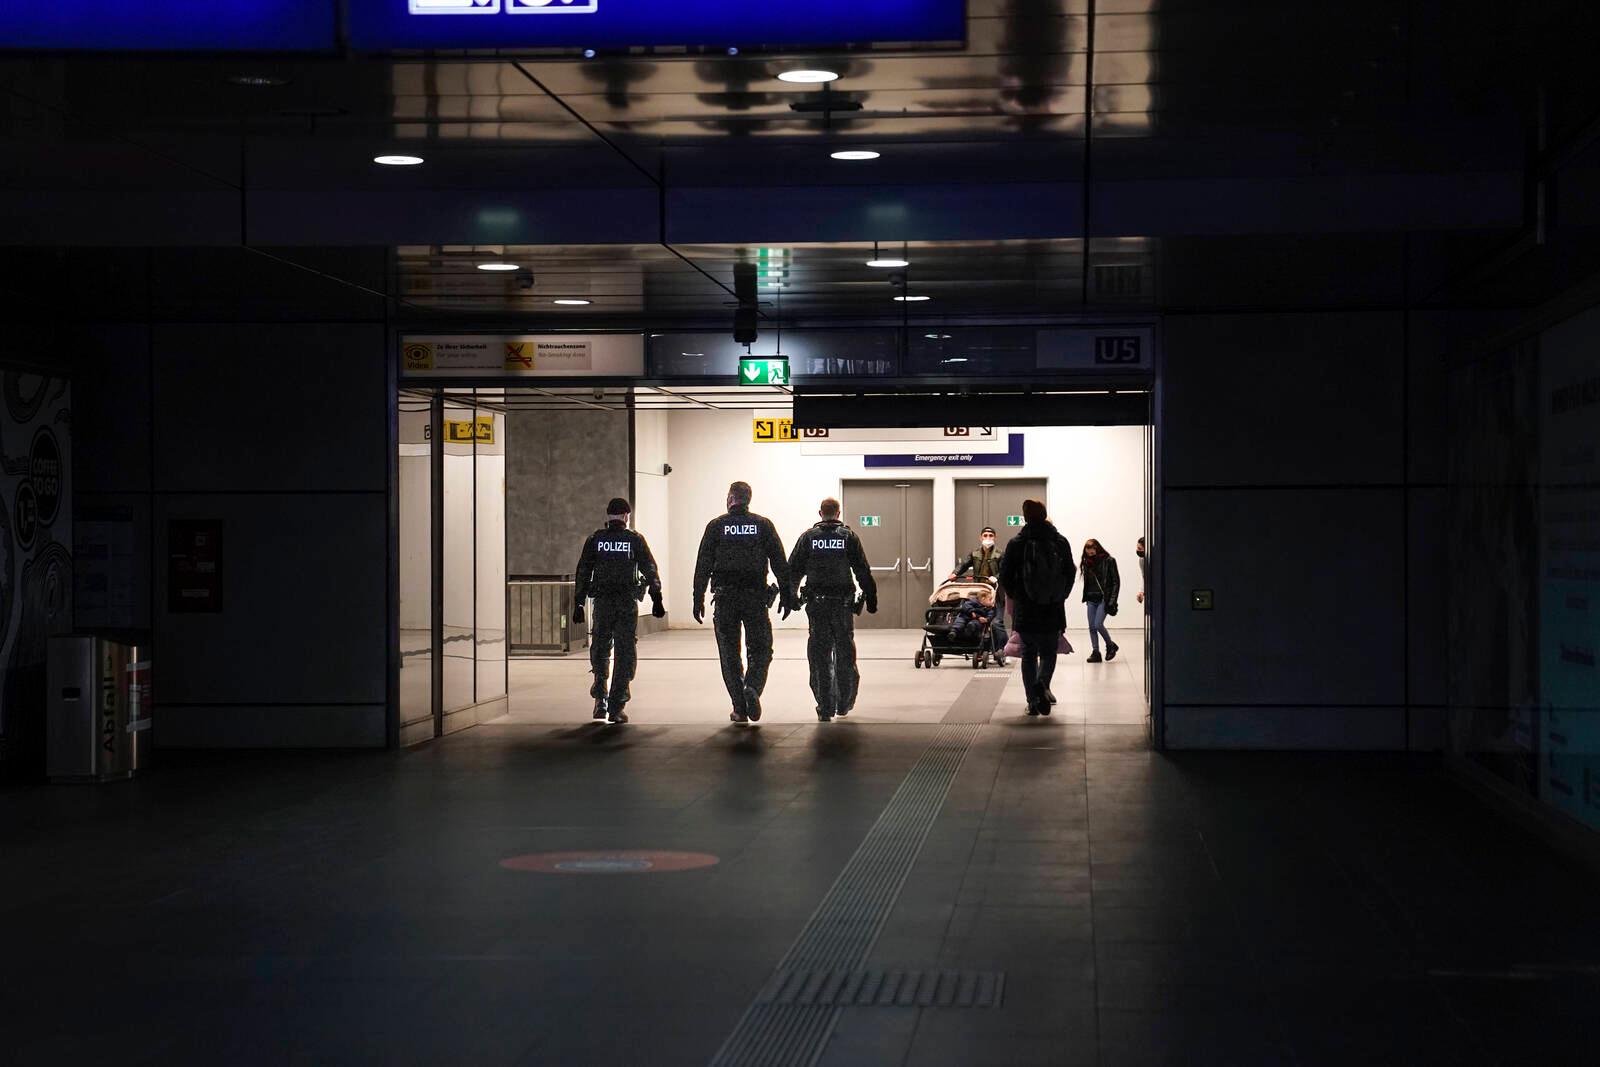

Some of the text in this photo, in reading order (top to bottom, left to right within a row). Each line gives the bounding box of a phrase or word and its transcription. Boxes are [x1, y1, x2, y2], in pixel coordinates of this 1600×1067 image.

[1100, 338, 1137, 361] U5
[915, 454, 947, 462] Emergency
[960, 454, 973, 462] only
[724, 524, 758, 535] POLIZEI
[597, 541, 631, 552] POLIZEI
[812, 539, 845, 550] POLIZEI
[103, 676, 115, 753] Abfall
